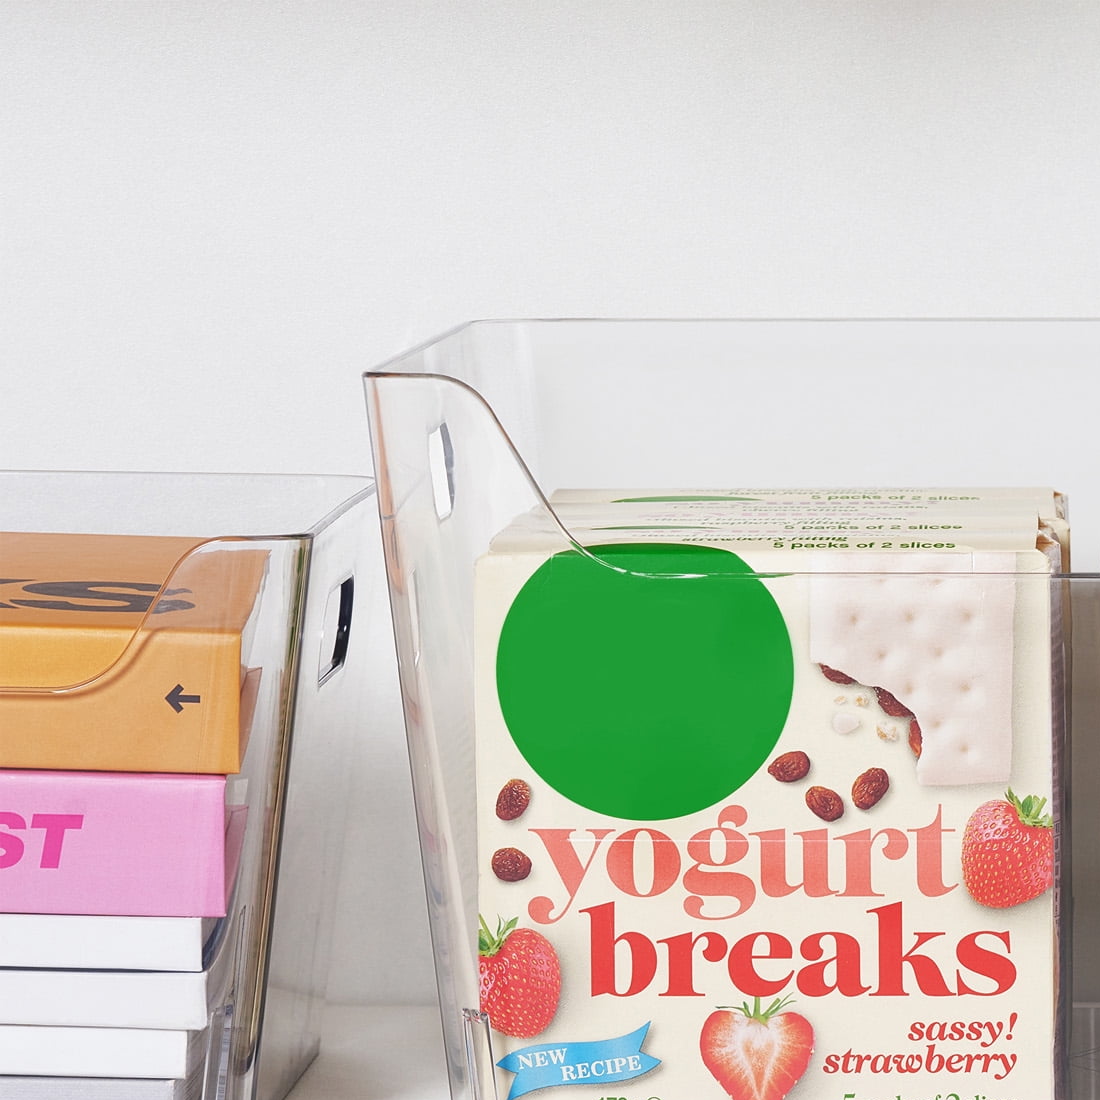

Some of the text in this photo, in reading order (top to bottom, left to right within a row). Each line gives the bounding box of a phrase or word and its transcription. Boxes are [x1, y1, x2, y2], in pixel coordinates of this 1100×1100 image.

[827, 494, 882, 502] packs
[773, 541, 785, 549] 5
[791, 541, 849, 550] packs
[856, 541, 876, 549] of
[900, 541, 956, 549] slices
[527, 803, 961, 925] yogurt
[578, 901, 1018, 998] breaks
[907, 1012, 1018, 1048] sassy!
[517, 1047, 568, 1071] NEW
[560, 1054, 643, 1083] RECIPE
[822, 1044, 1018, 1080] strawberry
